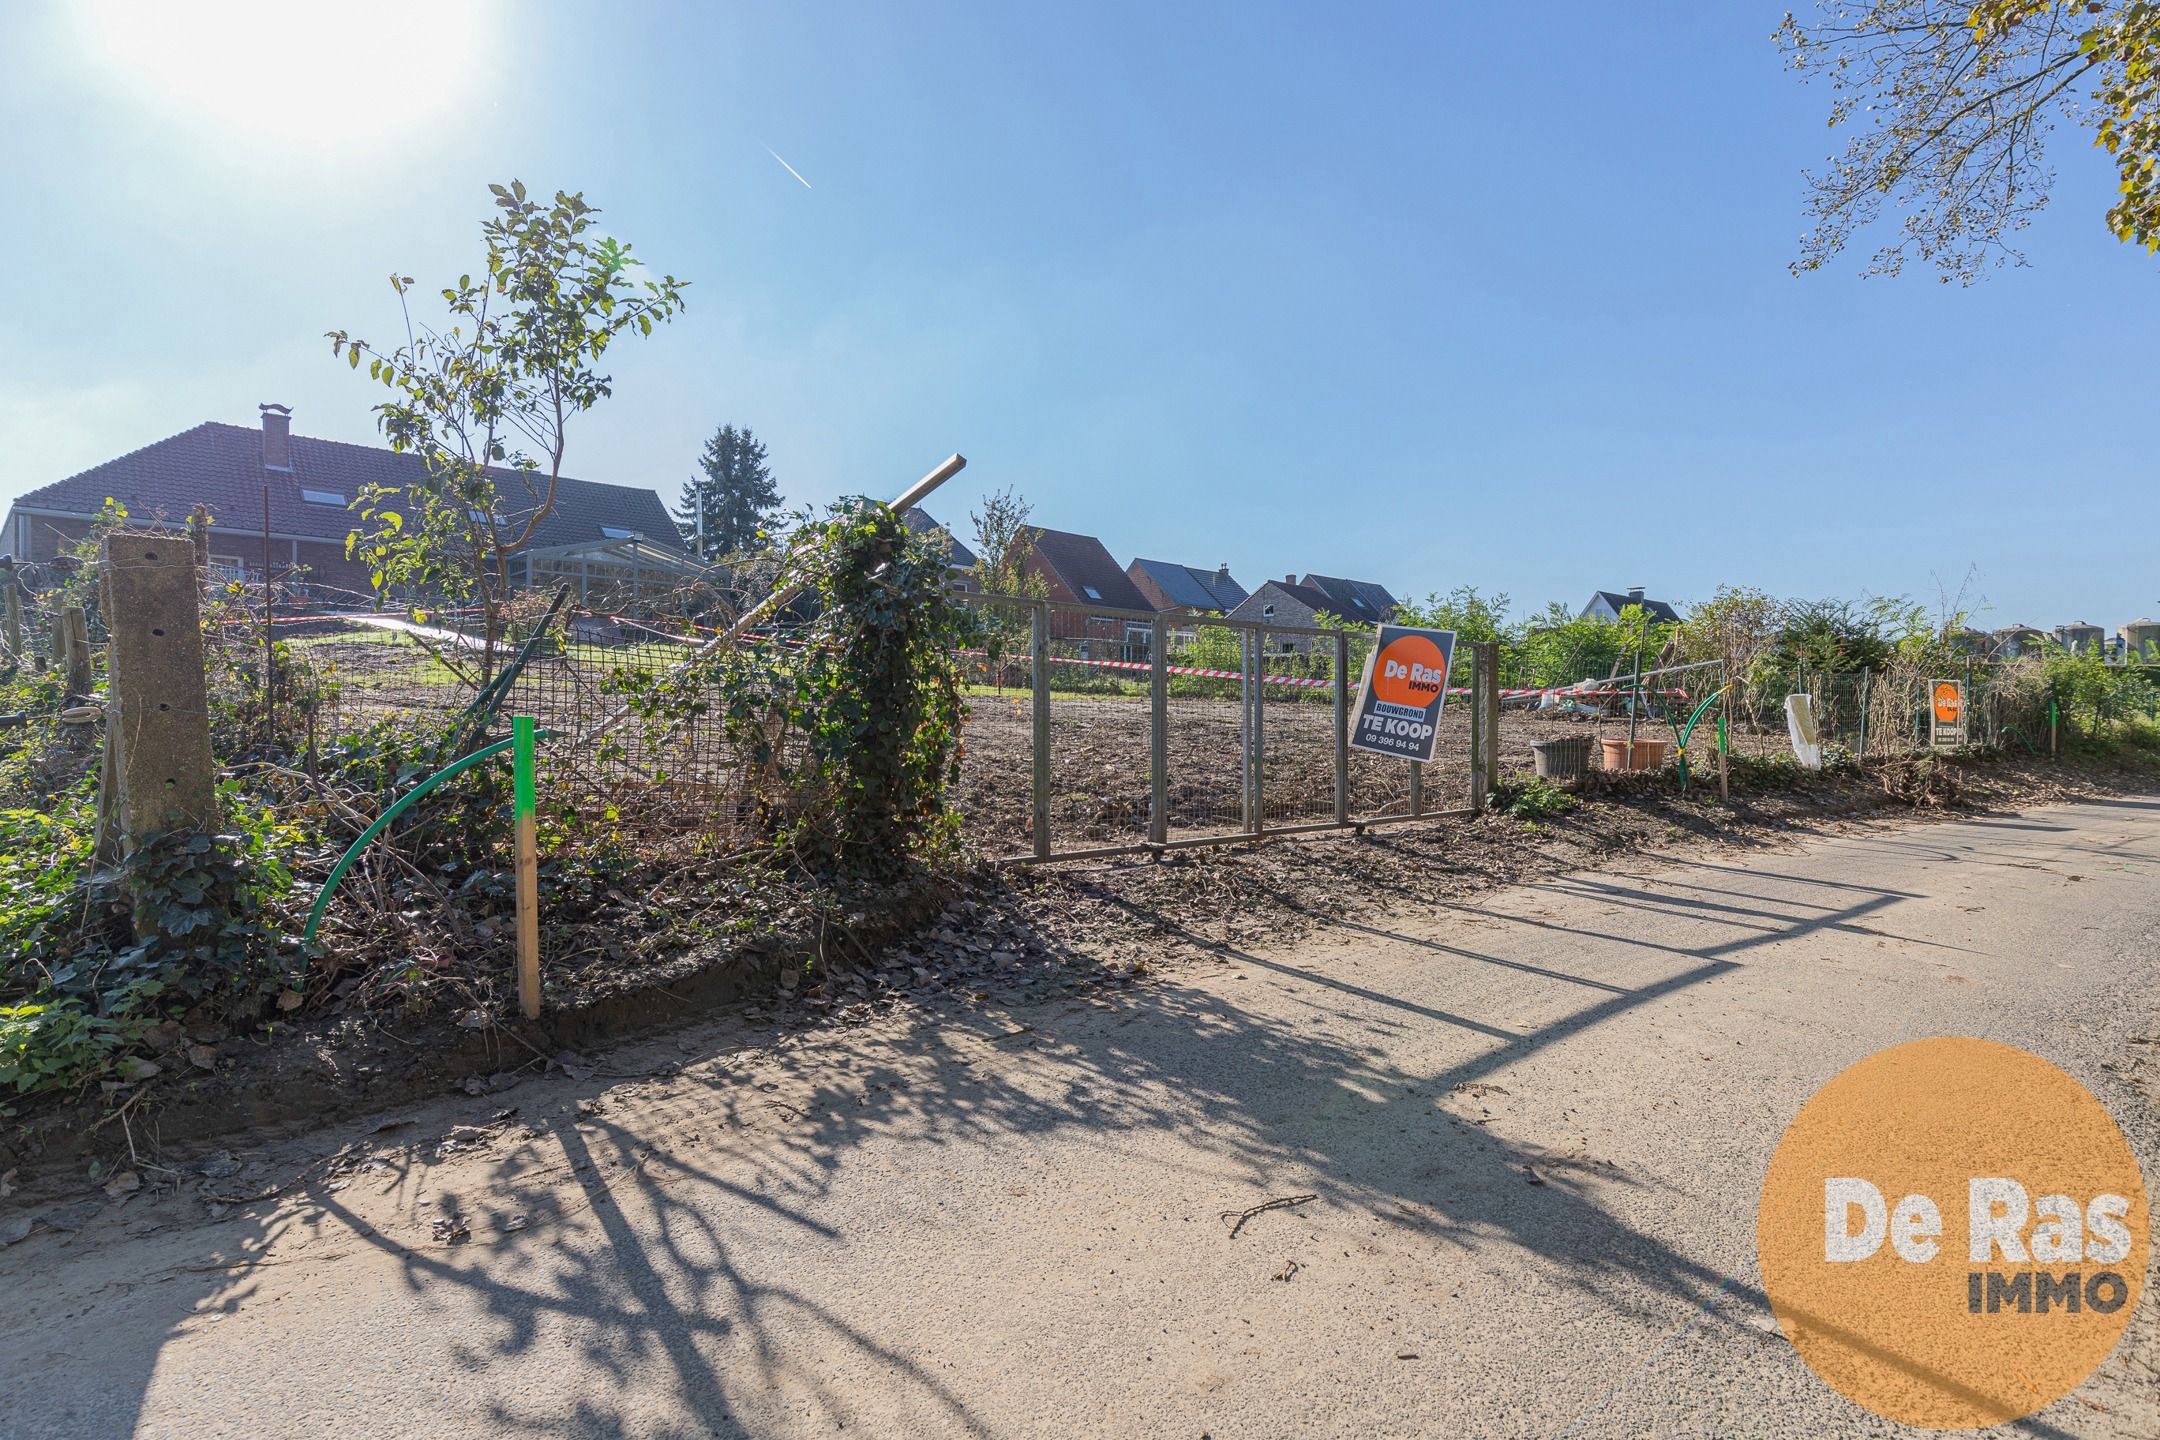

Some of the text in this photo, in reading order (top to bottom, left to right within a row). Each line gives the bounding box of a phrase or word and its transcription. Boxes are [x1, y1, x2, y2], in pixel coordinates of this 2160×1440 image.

[1384, 660, 1442, 684] De Ras
[1408, 681, 1439, 693] IMMO
[1376, 703, 1424, 720] BOUWGROND
[1363, 714, 1433, 740] TE KOOP
[1936, 728, 1957, 736] TE KOOP
[1365, 733, 1420, 751] 09 396 94 94
